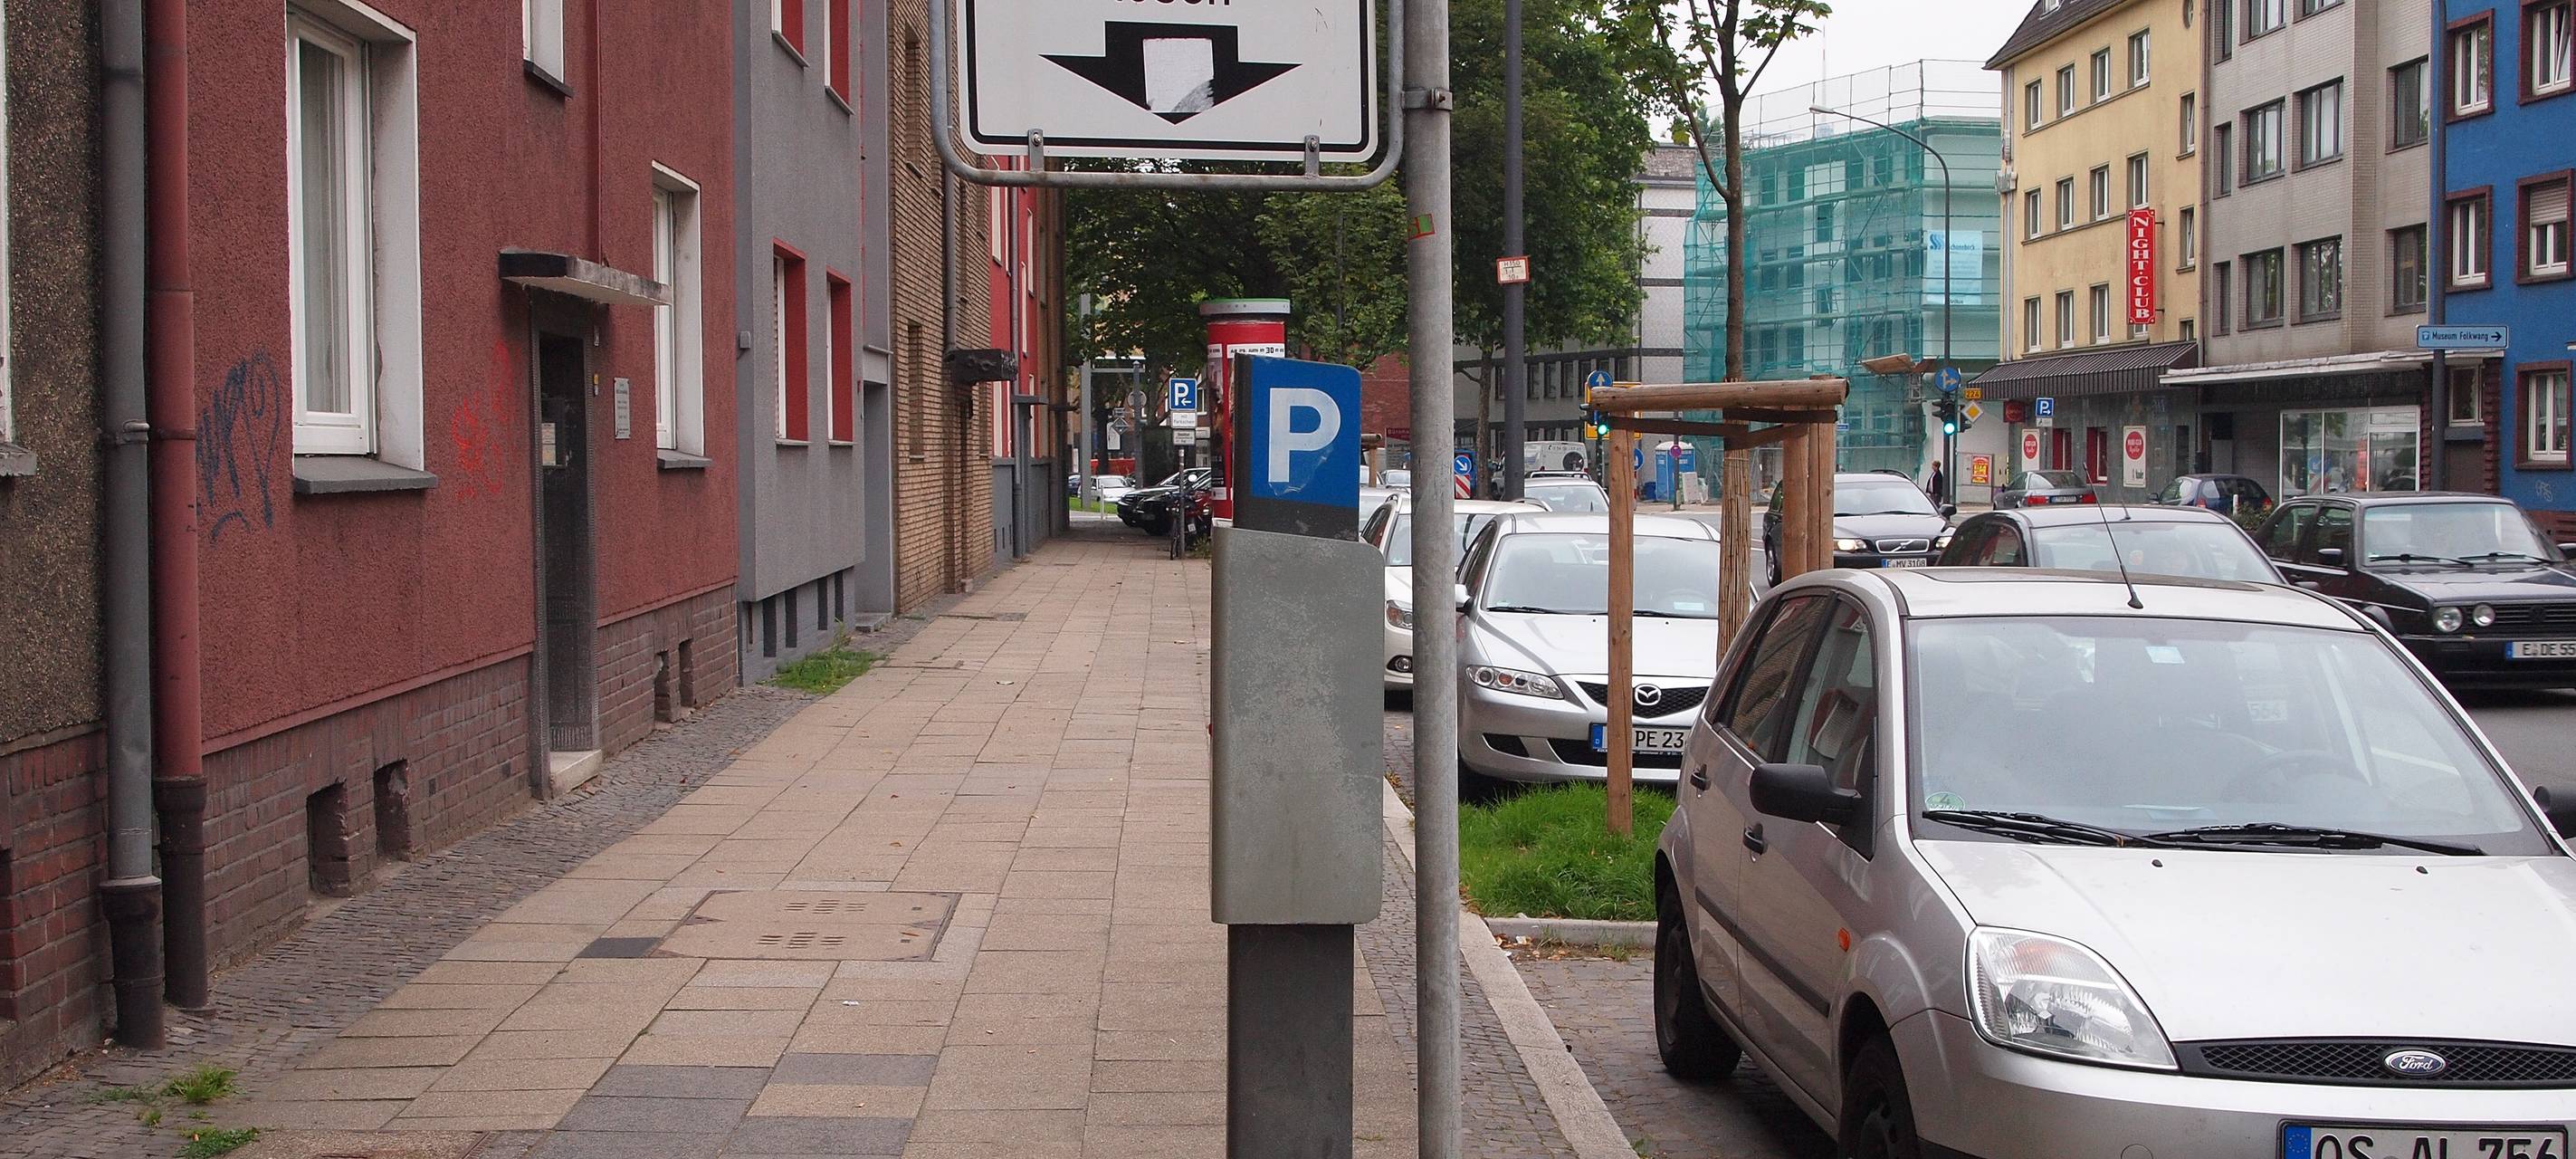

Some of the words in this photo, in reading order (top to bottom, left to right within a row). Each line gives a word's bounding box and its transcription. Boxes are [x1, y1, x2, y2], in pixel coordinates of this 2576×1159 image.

[2431, 331, 2457, 340] Museum
[2459, 331, 2489, 342] Folkwang
[1174, 382, 1189, 407] P
[2039, 400, 2049, 415] P
[1268, 388, 1340, 483] P
[2523, 643, 2532, 656] E
[2541, 643, 2557, 656] DE
[1635, 730, 1658, 748] PE
[1662, 731, 1687, 749] 23
[2399, 1055, 2434, 1070] Ford
